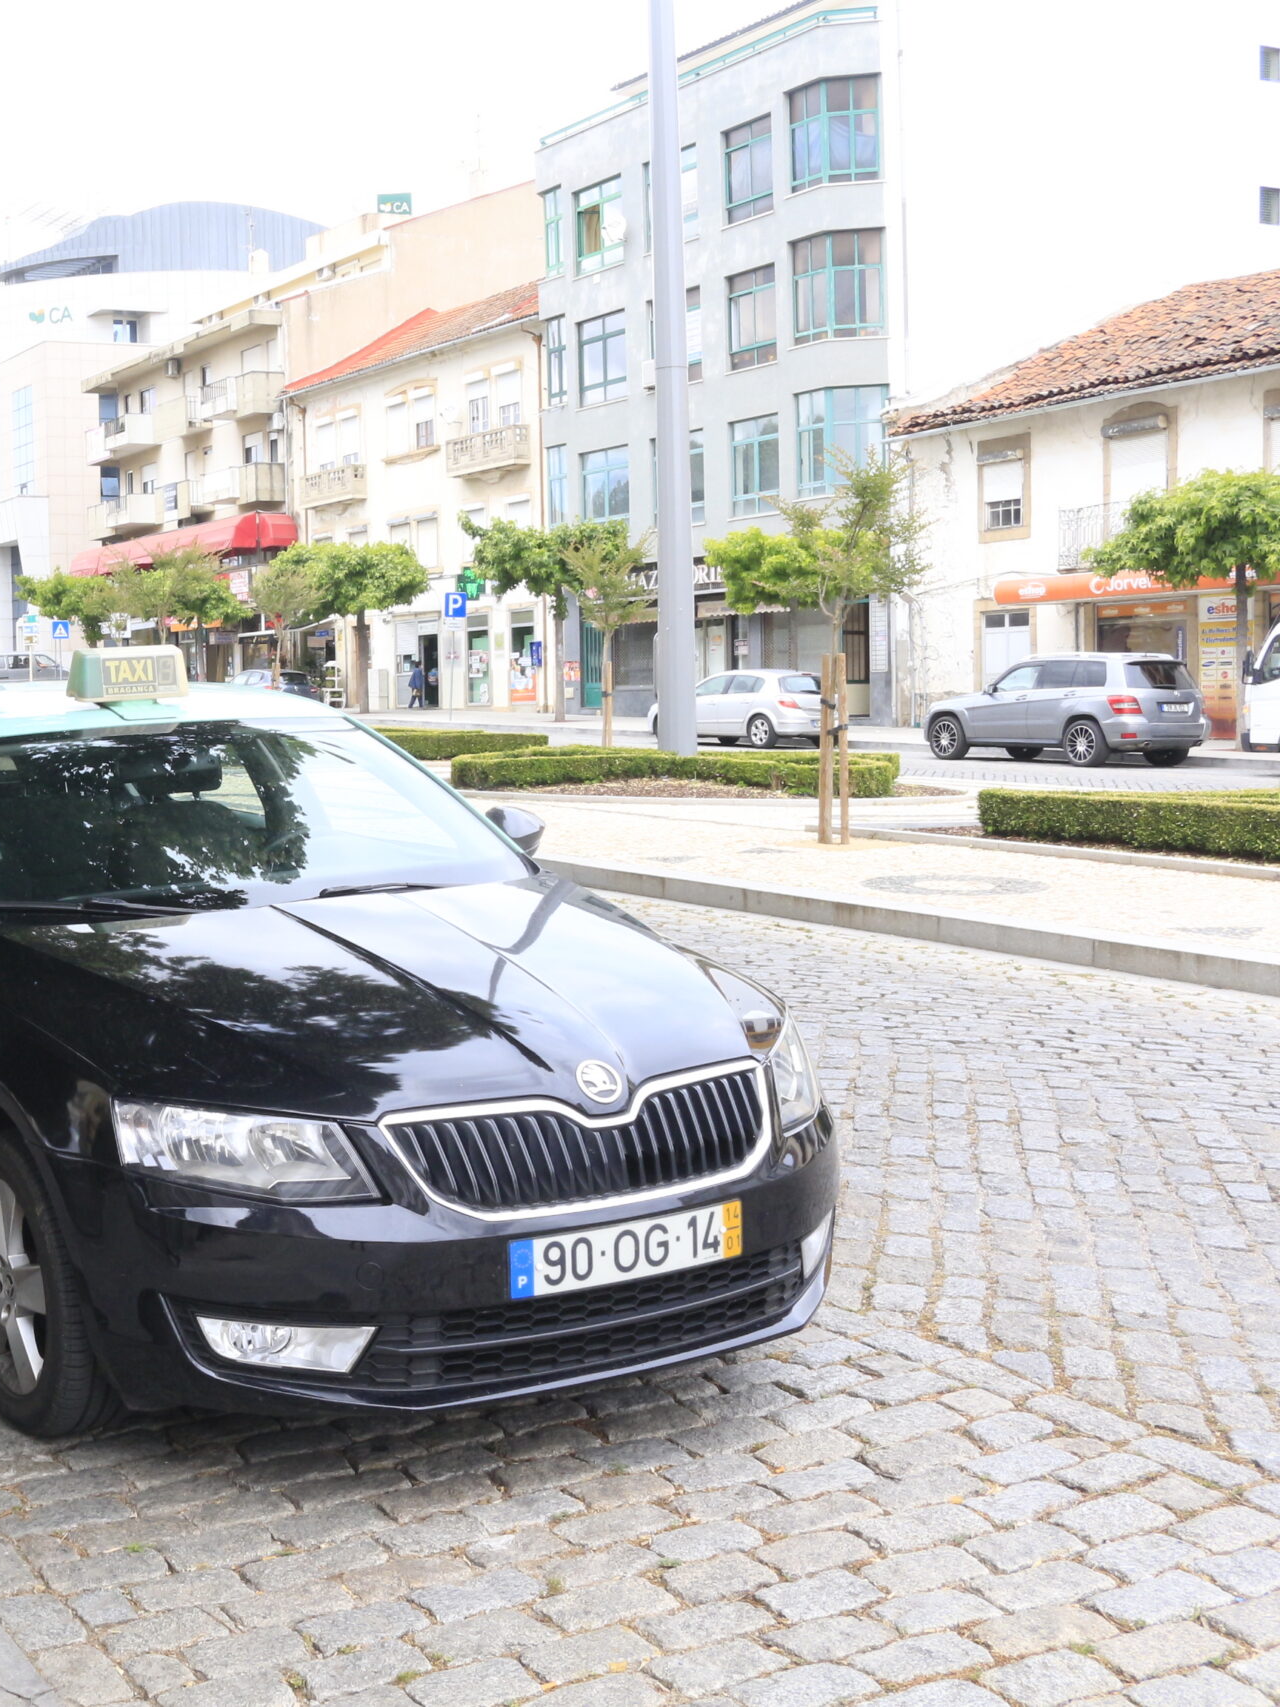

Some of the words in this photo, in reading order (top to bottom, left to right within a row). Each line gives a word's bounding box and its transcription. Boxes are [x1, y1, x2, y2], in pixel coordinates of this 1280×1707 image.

[393, 201, 410, 213] CA
[49, 305, 73, 324] CA
[448, 594, 462, 616] P
[1207, 602, 1238, 615] esho
[105, 659, 154, 683] TAXI
[725, 1204, 740, 1222] 14
[726, 1234, 740, 1250] 01
[517, 1276, 528, 1290] P
